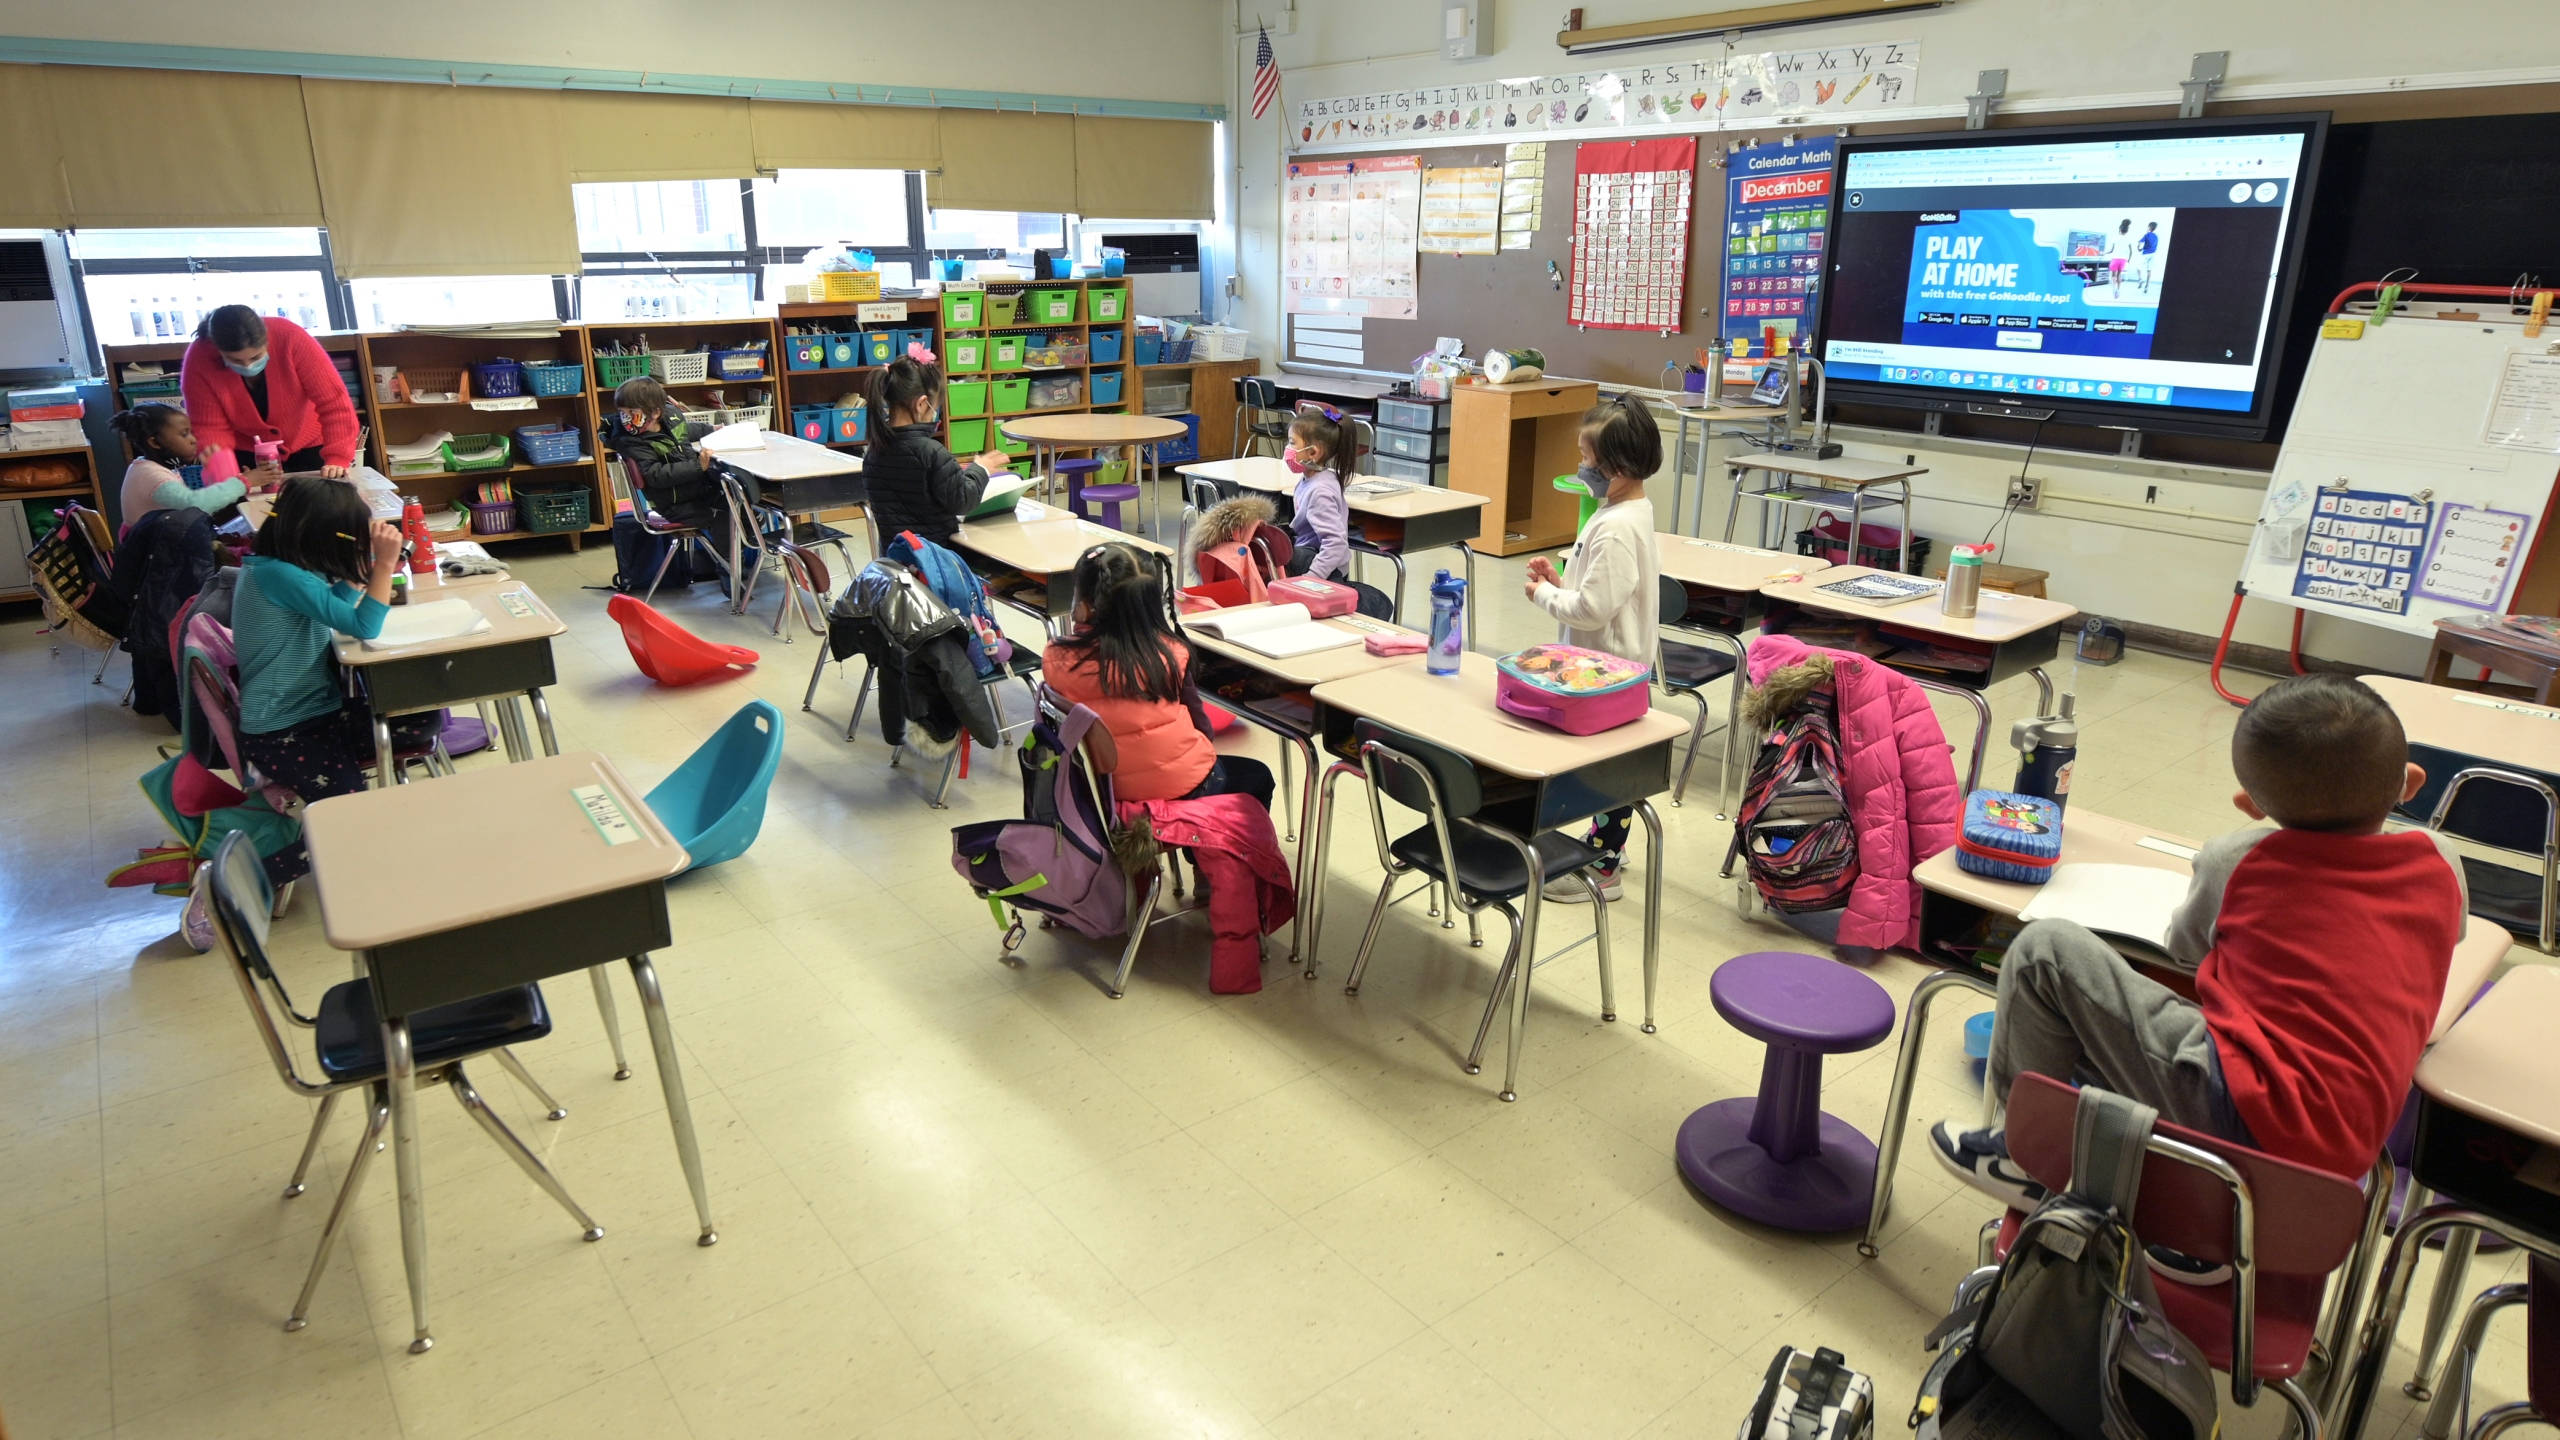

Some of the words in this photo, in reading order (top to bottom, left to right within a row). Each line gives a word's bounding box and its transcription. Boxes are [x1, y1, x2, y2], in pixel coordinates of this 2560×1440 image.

[1302, 104, 1314, 117] Aa
[1318, 103, 1328, 115] Bb
[1332, 100, 1344, 114] Cc
[1348, 98, 1360, 112] Dd
[1365, 97, 1376, 111] Ee
[1380, 95, 1390, 109] Ff
[1396, 94, 1410, 111] Gg
[1416, 92, 1427, 105] Hh
[1450, 88, 1460, 106] Jj
[1466, 86, 1478, 102] Kk
[1502, 84, 1522, 98] Mm
[1530, 82, 1544, 96] Nn
[1552, 78, 1570, 94] Oo
[1578, 76, 1590, 96] Pp
[1642, 68, 1655, 86] Rr
[1666, 66, 1680, 84] Ss
[1692, 64, 1706, 80] Tt
[1777, 54, 1804, 74] Ww
[1818, 51, 1837, 70] Xx
[1852, 48, 1872, 72] Yy
[1886, 45, 1904, 64] Zz
[1748, 154, 1800, 170] Calendar
[1802, 150, 1832, 164] Math
[1747, 178, 1824, 198] December
[1926, 236, 1983, 260] PLAY
[1748, 261, 1757, 270] 14
[1764, 260, 1772, 268] 15
[1778, 260, 1786, 268] 16
[1922, 262, 1952, 286] AT
[1954, 263, 2020, 288] HOME
[1732, 282, 1742, 290] 20
[1748, 282, 1756, 290] 21
[1762, 282, 1772, 290] 22
[1776, 281, 1787, 290] 23
[1792, 280, 1802, 288] 24
[1920, 290, 1944, 299] with
[1946, 290, 1963, 300] the
[1964, 290, 1987, 301] free
[1988, 291, 2042, 302] GoNoodle
[2043, 292, 2070, 304] App!
[1730, 304, 1740, 312] 27
[1746, 304, 1756, 312] 28
[1760, 303, 1770, 312] 29
[1776, 302, 1786, 310] 30
[1792, 302, 1800, 310] 31
[800, 350, 810, 360] a
[813, 348, 822, 360] b
[878, 345, 886, 358] d
[2325, 502, 2332, 510] a
[2344, 502, 2352, 512] b
[2374, 505, 2384, 516] d
[2394, 507, 2402, 515] e
[2414, 508, 2421, 520] f
[2451, 512, 2460, 520] a
[2316, 521, 2326, 532] g
[2336, 525, 2344, 536] h
[2367, 526, 2374, 540] j
[2388, 531, 2396, 542] k
[2445, 529, 2454, 538] e
[2309, 541, 2320, 550] m
[2326, 544, 2334, 552] o
[2342, 545, 2350, 555] p
[2380, 550, 2388, 558] r
[2398, 554, 2406, 562] s
[2432, 562, 2442, 571] o
[2317, 564, 2325, 572] u
[2331, 566, 2339, 574] v
[2344, 568, 2354, 577] w
[2358, 570, 2367, 579] x
[2374, 572, 2382, 582] y
[2395, 576, 2404, 585] z
[2426, 578, 2435, 586] u
